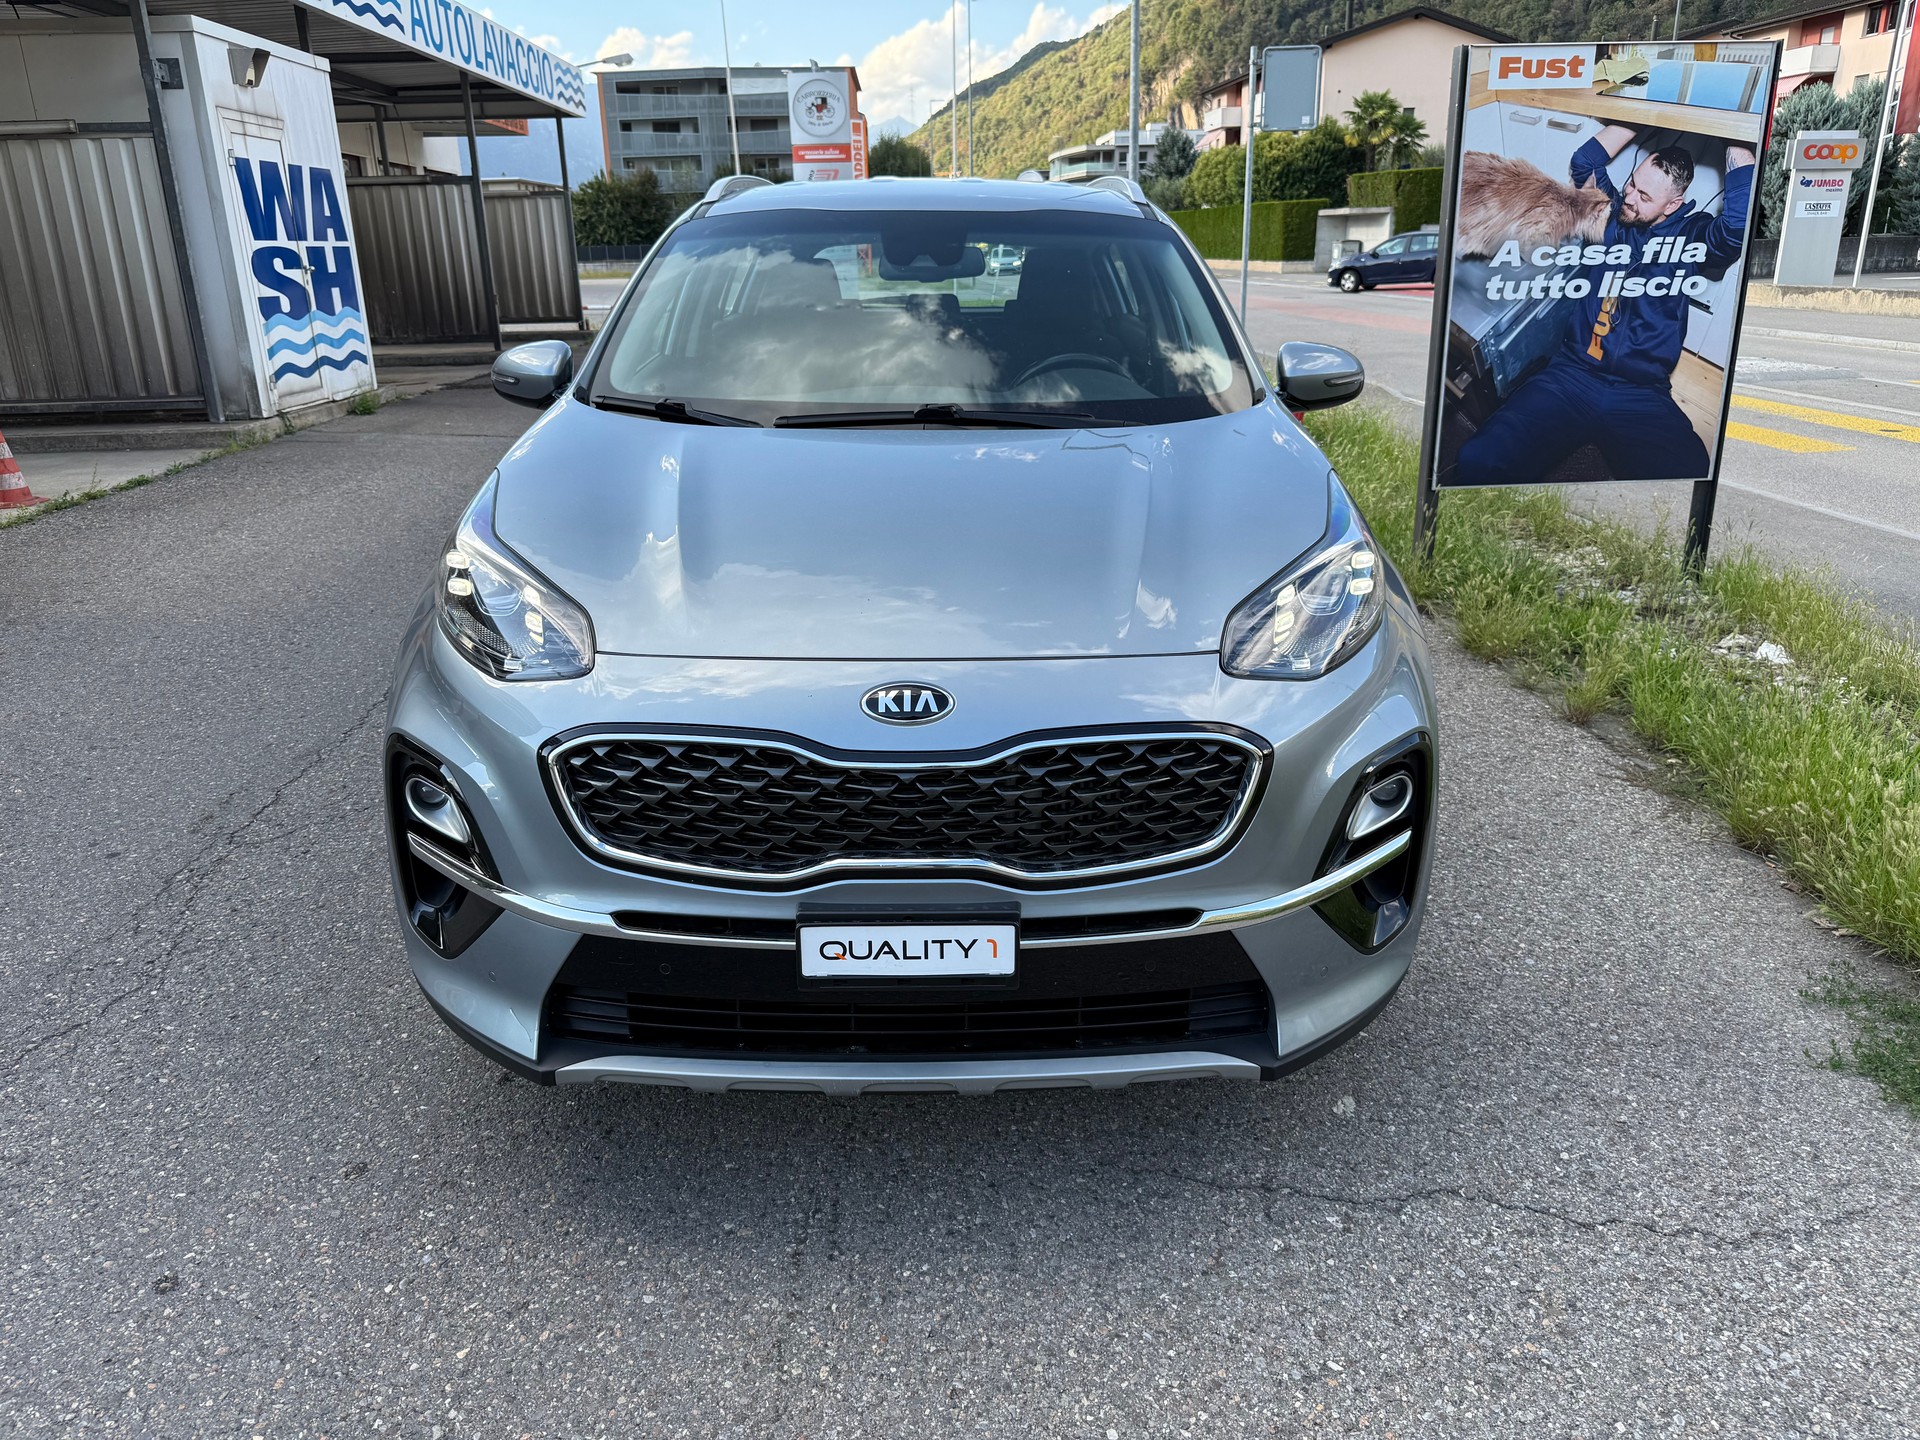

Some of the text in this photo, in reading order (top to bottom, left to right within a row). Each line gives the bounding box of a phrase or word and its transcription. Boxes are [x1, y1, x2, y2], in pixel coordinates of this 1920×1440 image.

[410, 0, 555, 100] AUTOLAVACCIO
[1498, 55, 1585, 80] Fust
[1803, 144, 1858, 164] coop
[1811, 179, 1844, 187] JUMBO
[1489, 236, 1708, 267] A casa fila
[1485, 269, 1709, 301] tutto liscio
[877, 689, 939, 713] KIA
[819, 938, 998, 961] QUALITY 1
